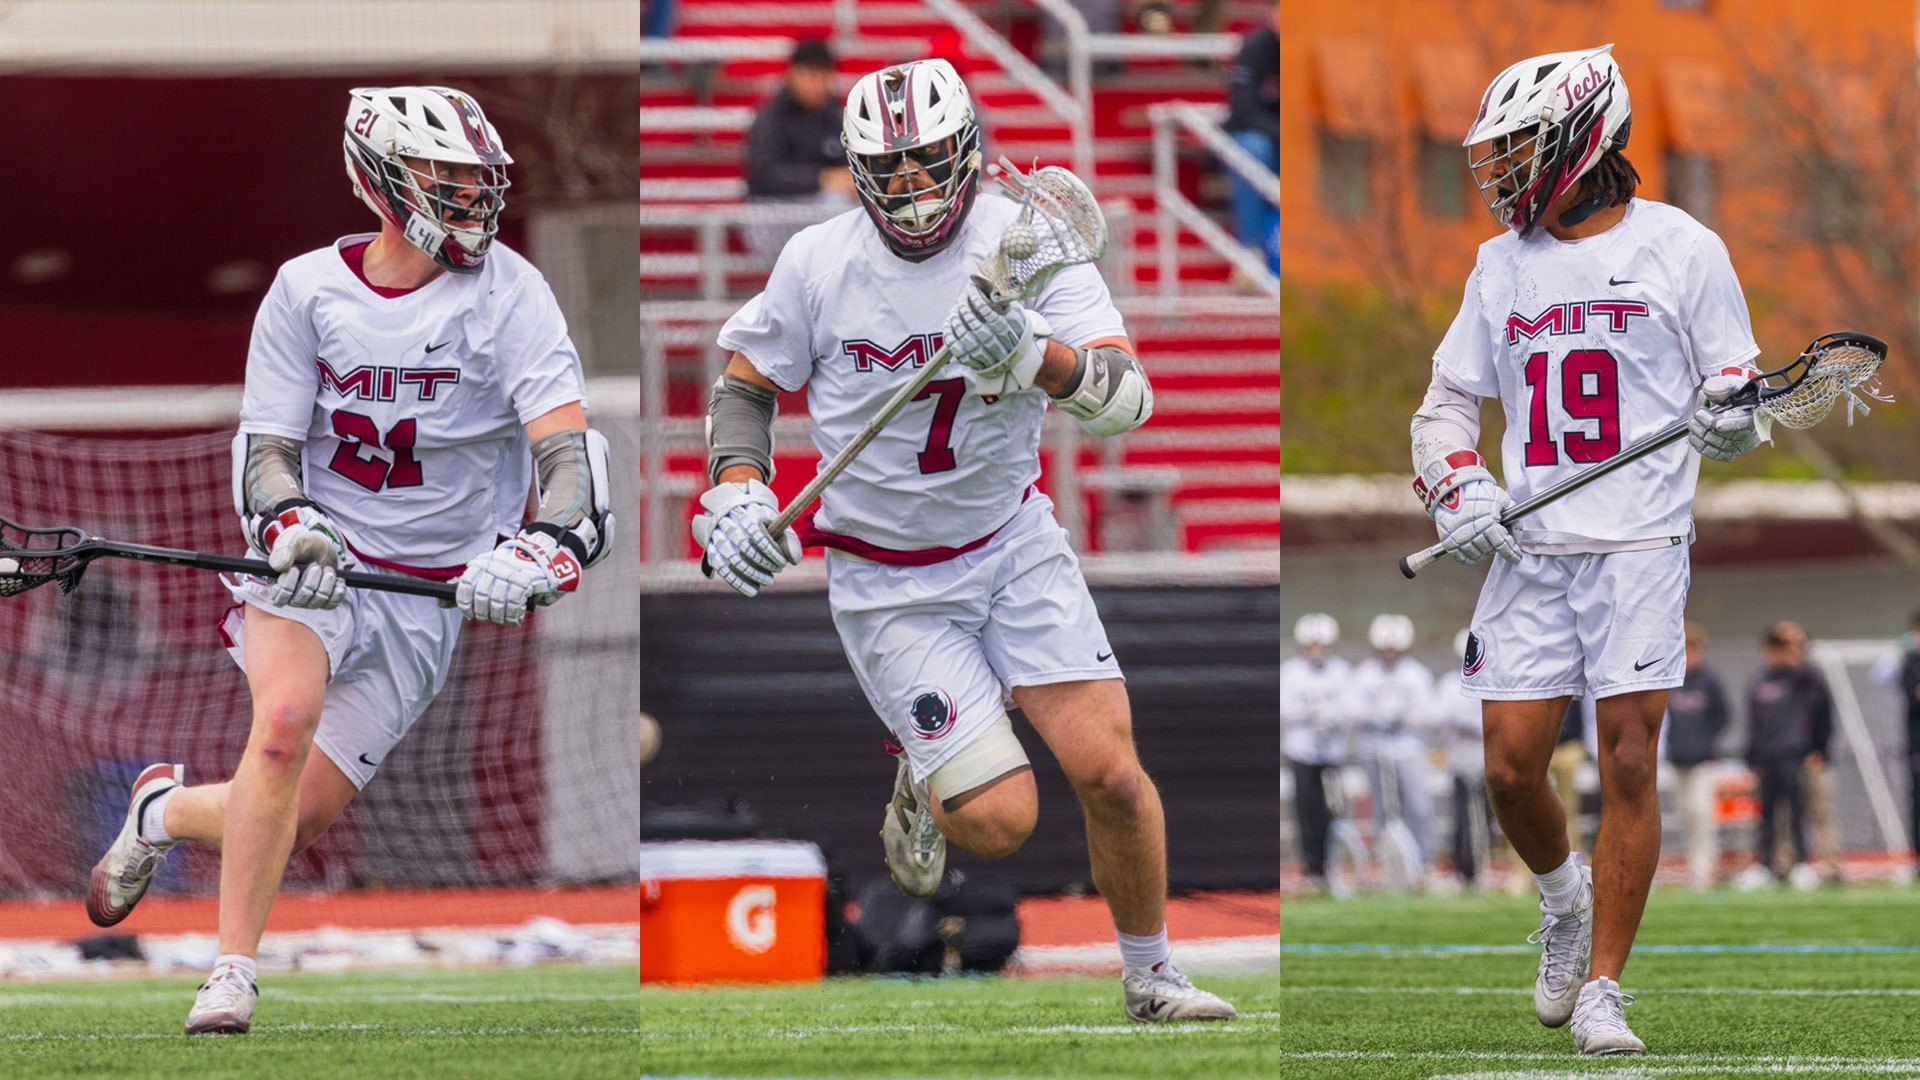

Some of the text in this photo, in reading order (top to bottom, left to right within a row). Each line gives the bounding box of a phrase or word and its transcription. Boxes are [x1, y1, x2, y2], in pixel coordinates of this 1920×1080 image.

[354, 108, 380, 139] 21
[1504, 299, 1650, 346] MIT
[842, 332, 950, 373] MI
[316, 356, 461, 402] MIT
[910, 376, 966, 475] 7
[1524, 349, 1622, 468] 19
[328, 408, 424, 493] 21
[554, 560, 578, 585] 21
[726, 884, 777, 955] G
